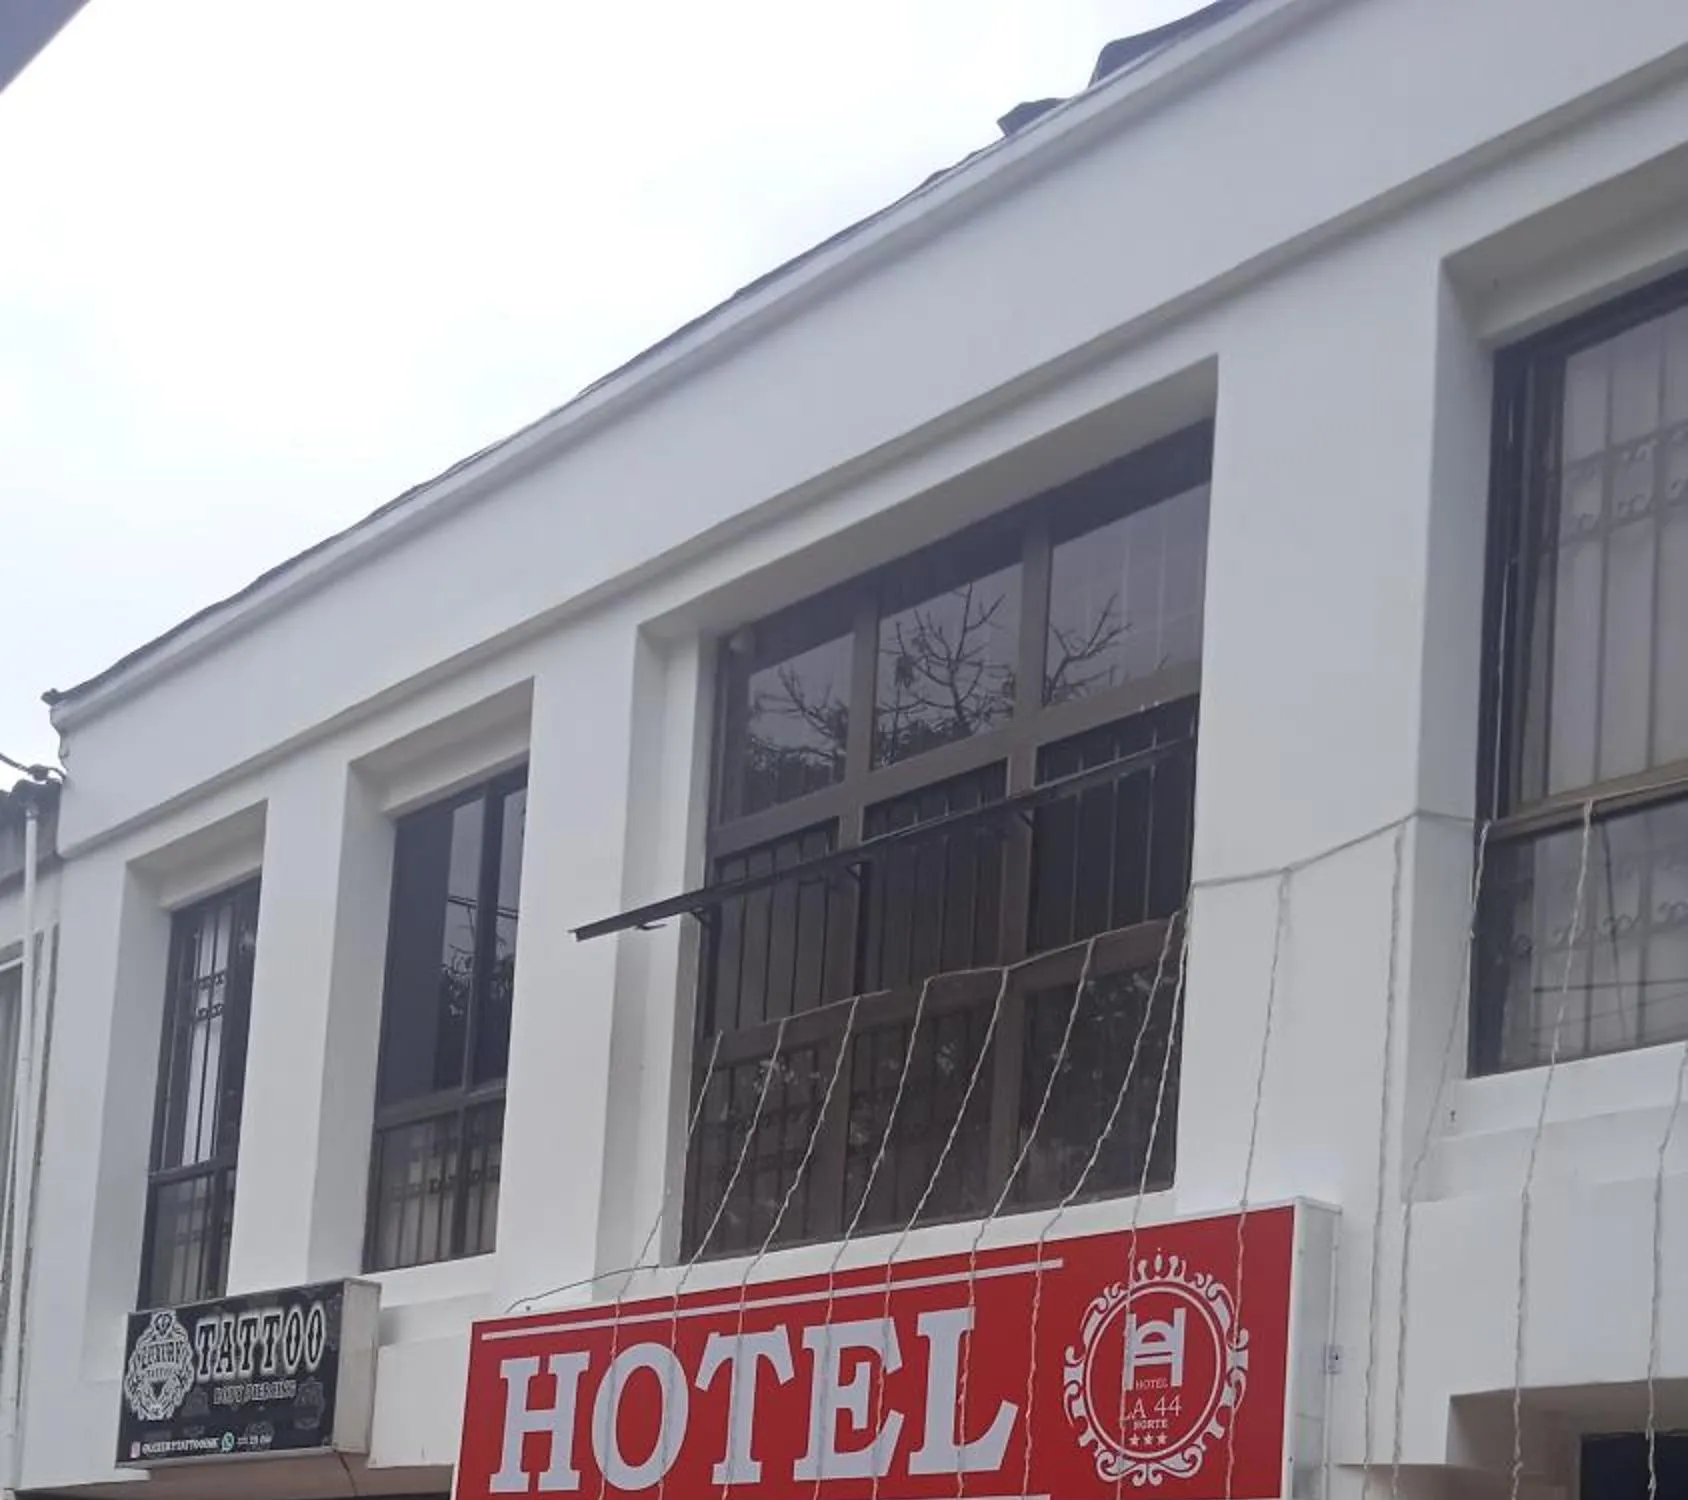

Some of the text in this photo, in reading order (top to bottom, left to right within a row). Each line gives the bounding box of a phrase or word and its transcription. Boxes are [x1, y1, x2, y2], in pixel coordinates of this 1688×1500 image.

[197, 1305, 324, 1380] TATTOO
[1135, 1377, 1169, 1391] HOTEL
[489, 1306, 1018, 1494] HOTEL
[1153, 1394, 1182, 1417] 44
[1133, 1418, 1168, 1431] NORTE
